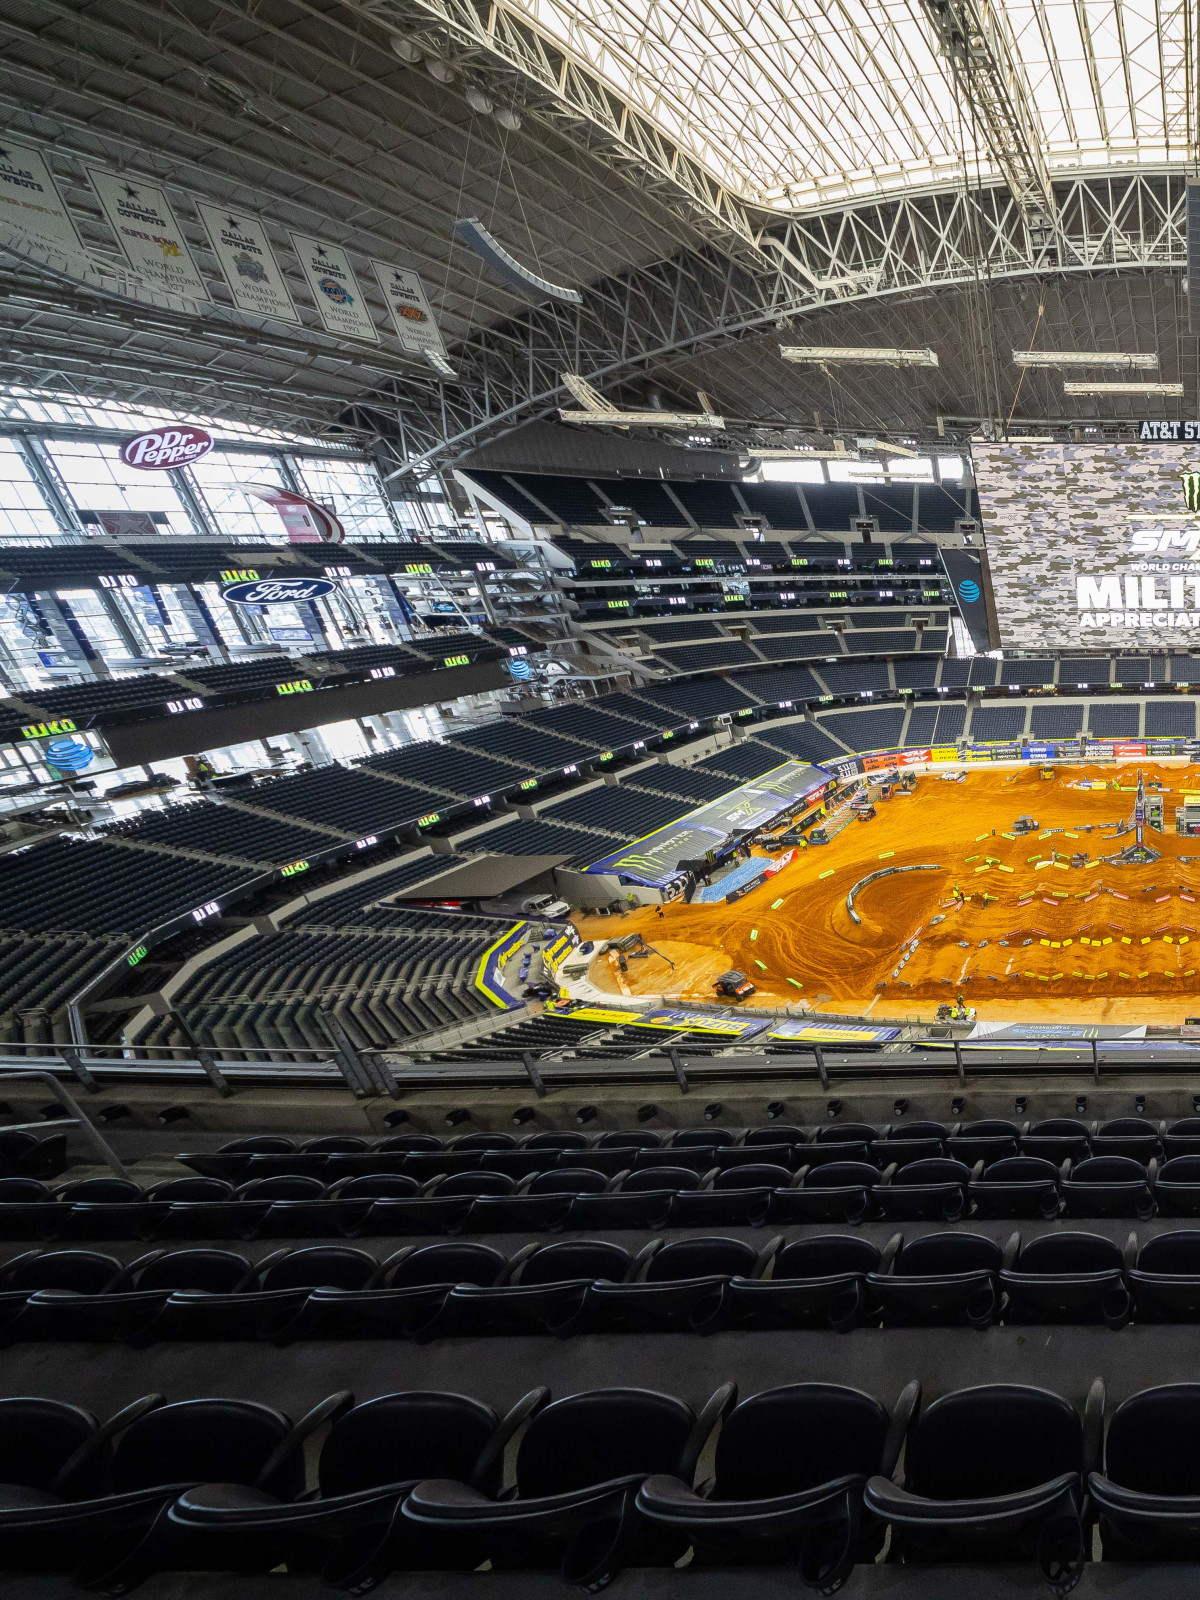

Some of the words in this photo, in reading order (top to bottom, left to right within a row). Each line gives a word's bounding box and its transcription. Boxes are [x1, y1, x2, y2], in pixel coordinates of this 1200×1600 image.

[0, 163, 33, 180] LLAS
[0, 173, 44, 192] WBOYS
[117, 199, 158, 216] DALLAS
[117, 208, 166, 227] COWBOYS
[120, 226, 151, 241] SUPER
[221, 230, 255, 246] DALLAS
[221, 237, 263, 255] COWBOYS
[143, 257, 184, 274] WORLD
[312, 257, 340, 271] DALLAS
[312, 264, 346, 280] COWBOYS
[136, 266, 201, 287] CHAMPIONS
[242, 282, 277, 298] WORLD
[390, 283, 414, 295] DALLAS
[235, 288, 291, 309] CHAMPIONS
[257, 303, 278, 314] 1992
[330, 305, 359, 319] WORLD
[325, 312, 371, 329] CHAMPIONS
[405, 325, 431, 337] WORLD
[1140, 421, 1181, 439] AT&T
[160, 431, 194, 449] Dr
[126, 434, 209, 466] Pepper
[324, 567, 337, 577] DJ
[337, 566, 351, 577] KO
[1131, 563, 1171, 572] WORLD
[98, 576, 116, 588] DJ
[118, 575, 138, 587] KO
[245, 581, 318, 601] Ford
[371, 669, 382, 678] DJ
[382, 667, 395, 676] KO
[167, 700, 184, 713] DJ
[184, 697, 203, 709] KO
[666, 874, 689, 898] 5.11
[193, 907, 206, 921] DJ
[203, 901, 219, 915] KO
